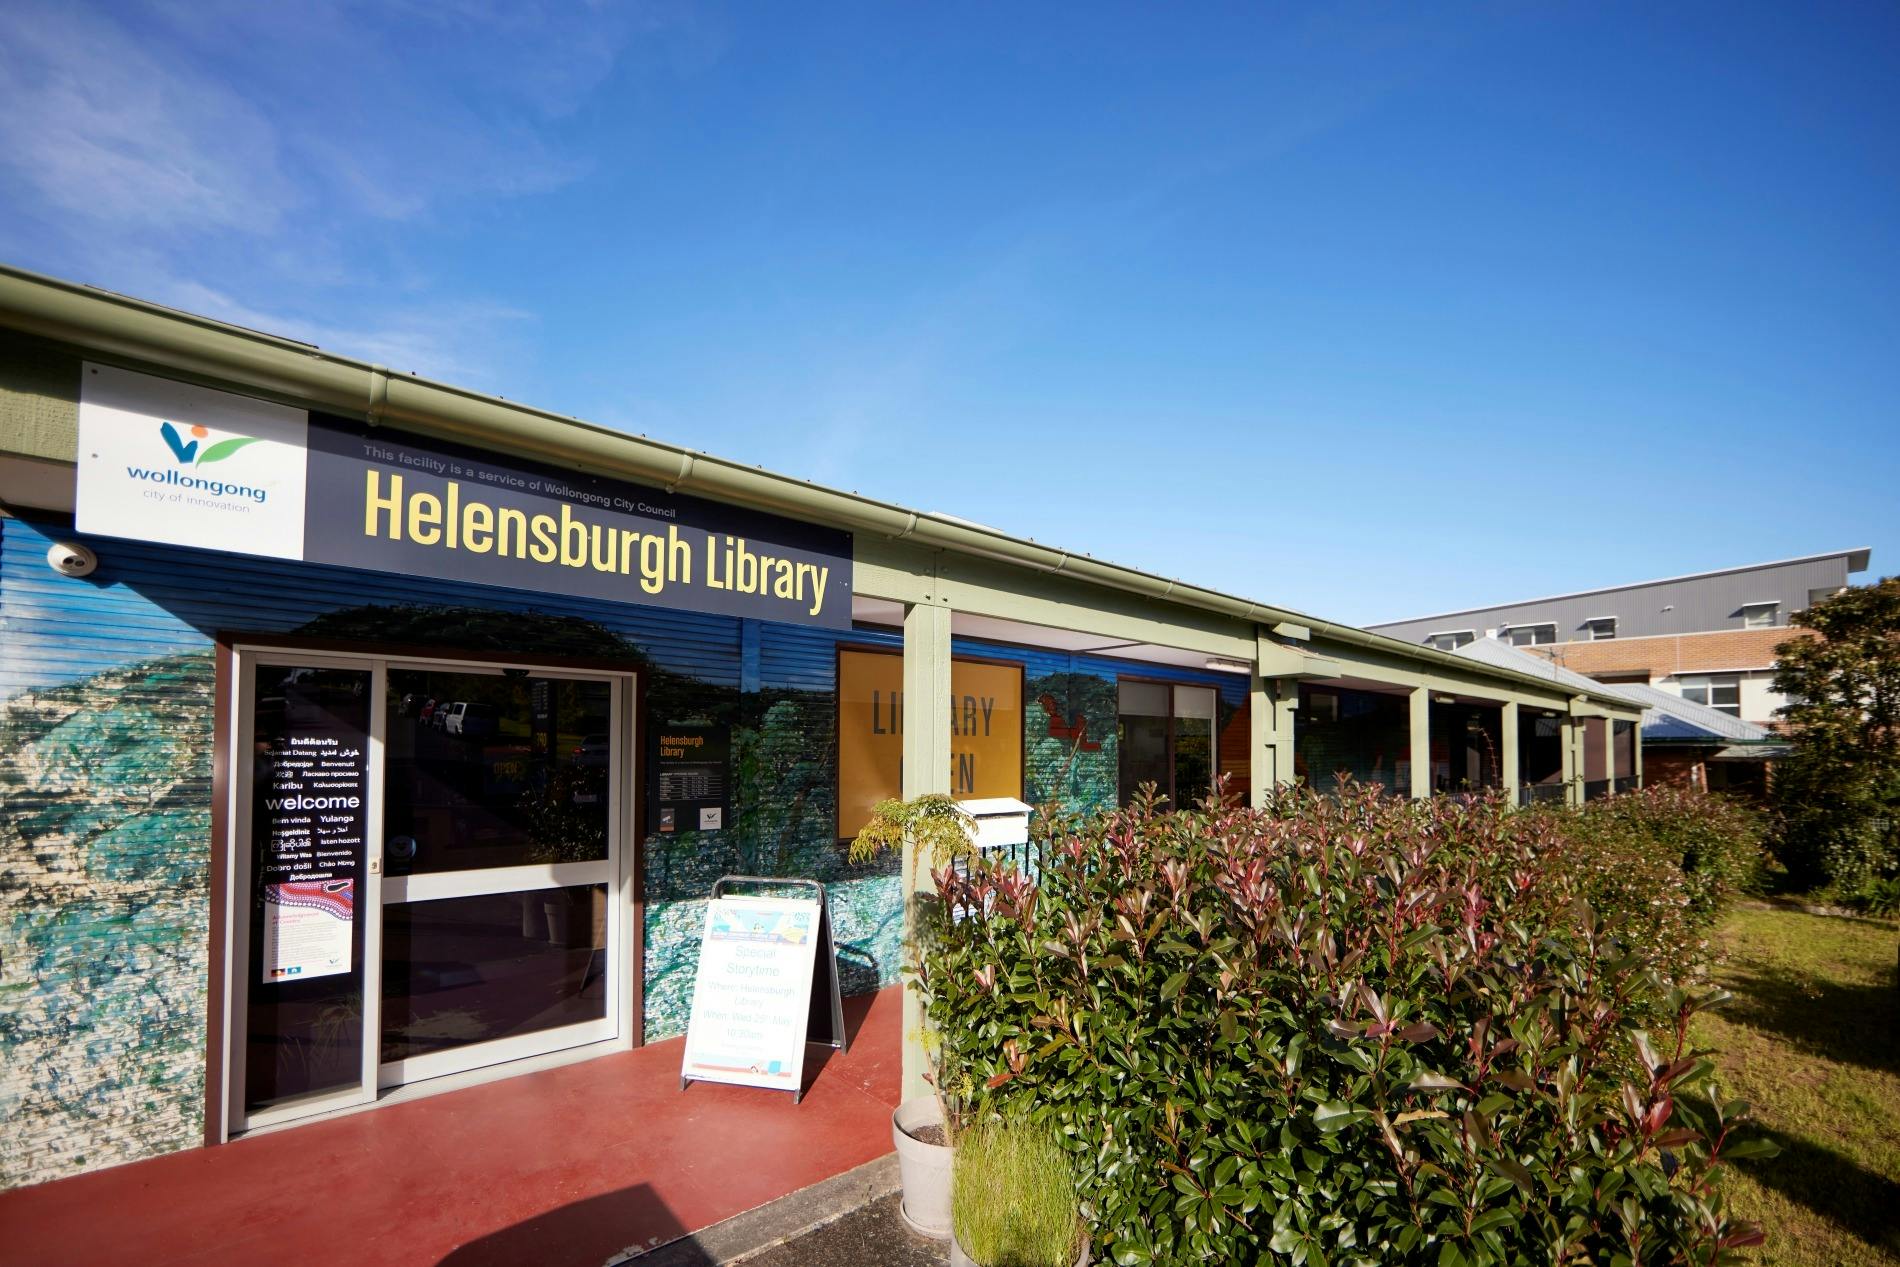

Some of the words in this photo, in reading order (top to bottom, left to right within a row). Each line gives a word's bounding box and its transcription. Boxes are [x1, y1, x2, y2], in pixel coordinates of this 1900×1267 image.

[127, 465, 267, 503] wollongong
[363, 444, 395, 462] This
[397, 450, 446, 474] facility
[449, 461, 462, 476] is
[465, 467, 475, 479] a
[478, 470, 526, 488] service
[528, 479, 542, 492] of
[544, 482, 611, 507] Wollongong
[613, 495, 636, 513] City
[637, 502, 677, 518] Council
[143, 488, 166, 503] city
[169, 491, 183, 504] of
[186, 496, 251, 514] innovation
[365, 469, 692, 595] Helensburgh
[706, 535, 830, 617] Library
[660, 736, 704, 748] Helensburgh
[292, 749, 317, 757] Datang
[660, 747, 684, 758] Library
[273, 782, 303, 790] Karibu
[265, 794, 360, 810] welcome
[320, 815, 354, 823] Yulanga
[735, 945, 777, 961] Special
[726, 962, 780, 978] Storytime
